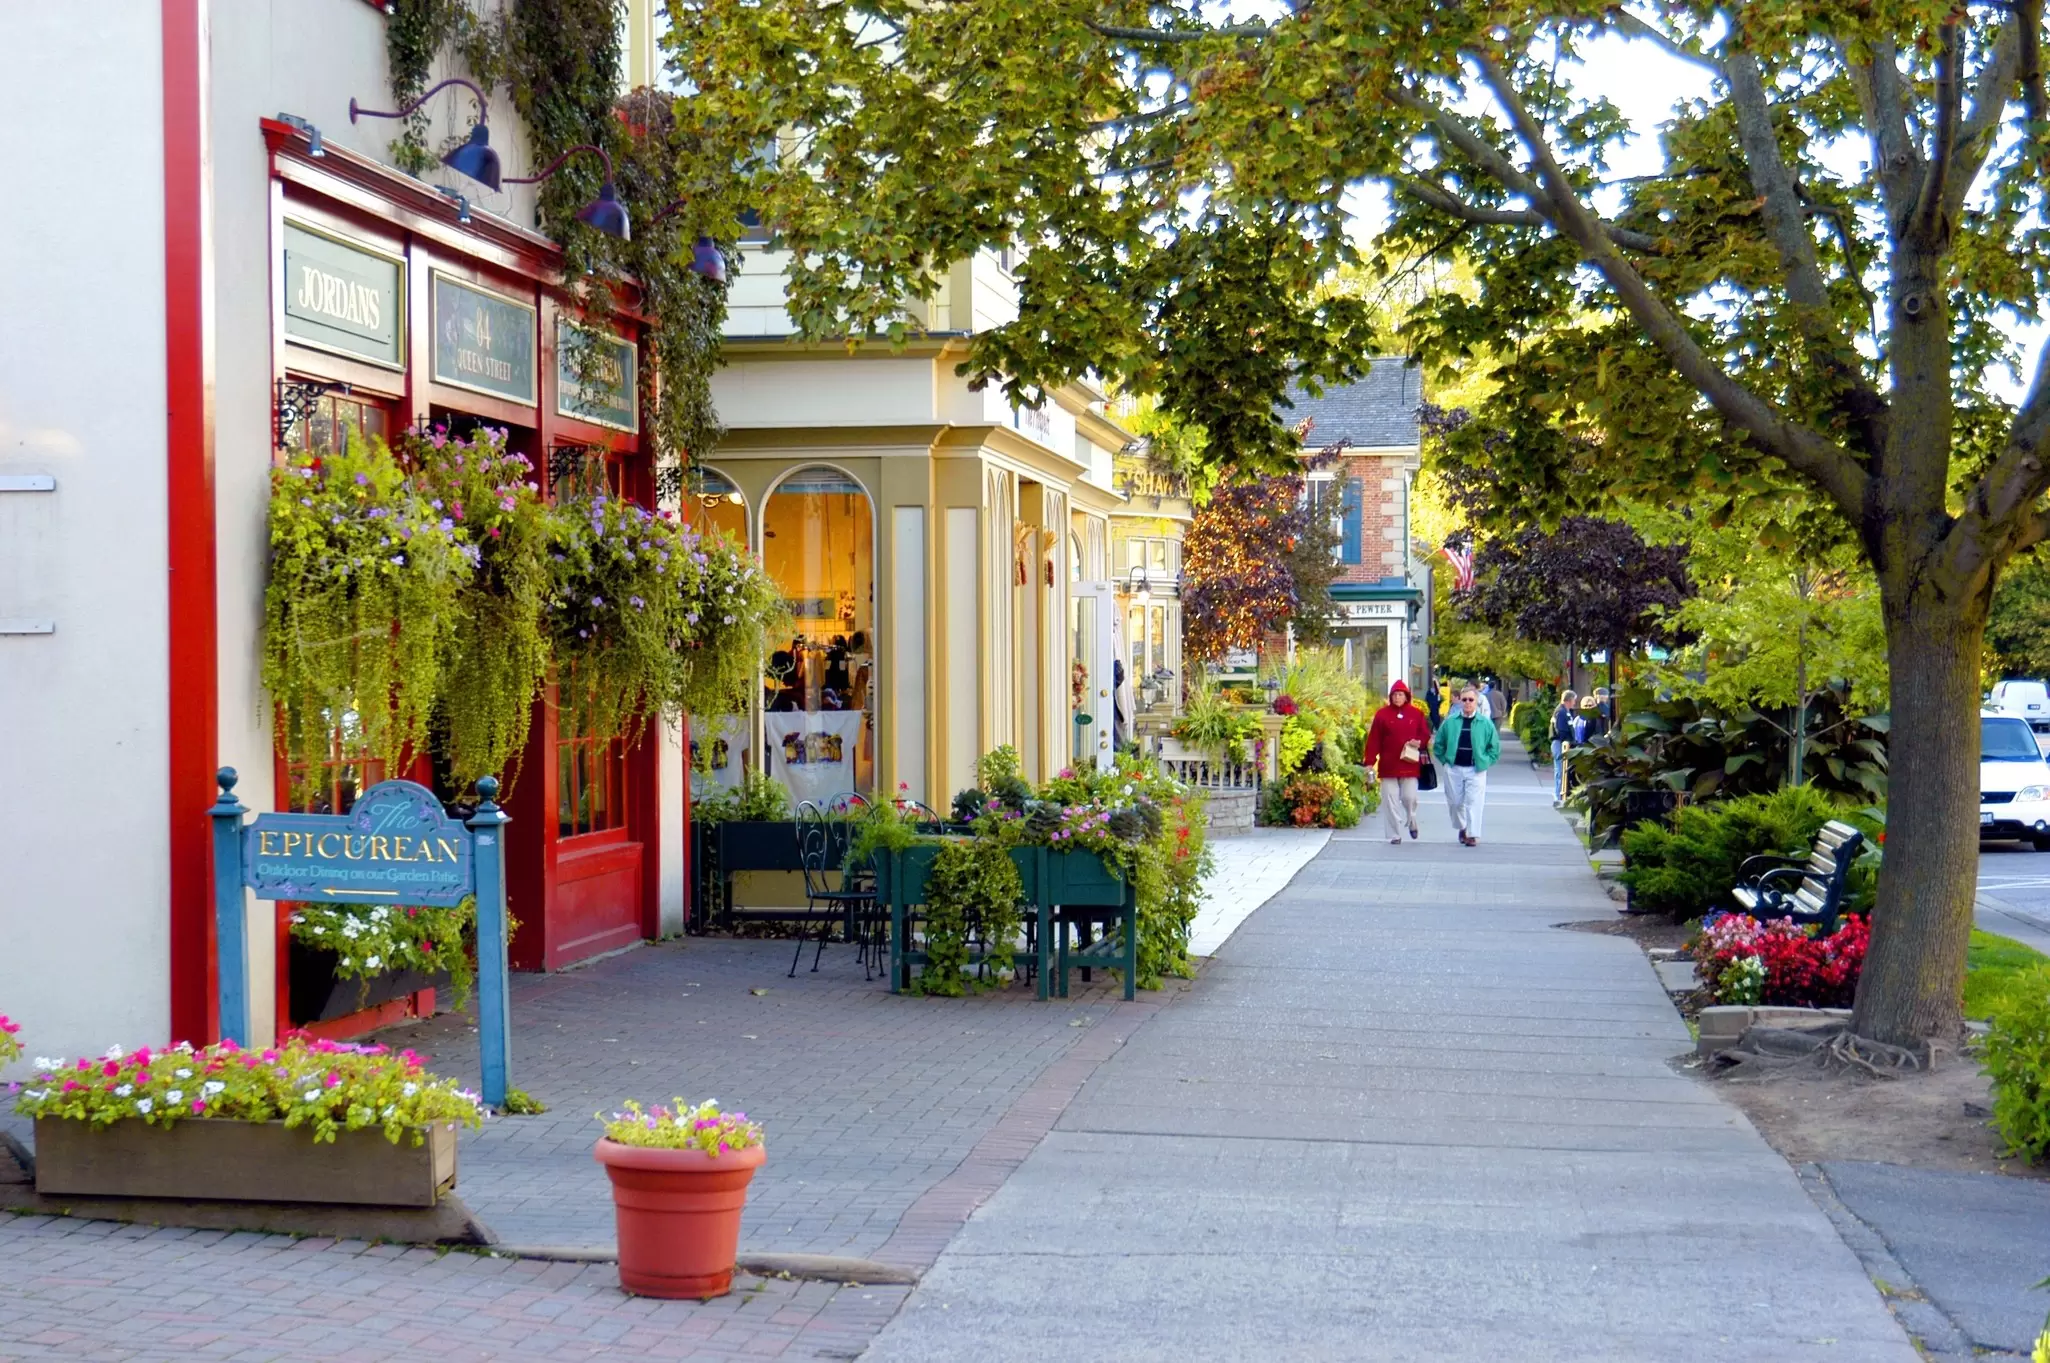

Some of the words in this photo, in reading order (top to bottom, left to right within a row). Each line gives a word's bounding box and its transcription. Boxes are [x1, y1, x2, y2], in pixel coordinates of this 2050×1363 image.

[298, 265, 380, 330] JORDANS
[476, 306, 492, 350] 84
[457, 348, 483, 374] QUEEN
[485, 356, 512, 382] STREET
[1356, 604, 1393, 614] PEWTER
[353, 801, 420, 854] The
[259, 831, 461, 864] EPICUREAN
[259, 863, 309, 877] Outdoor
[309, 865, 349, 880] Dining
[387, 868, 429, 882] Garden
